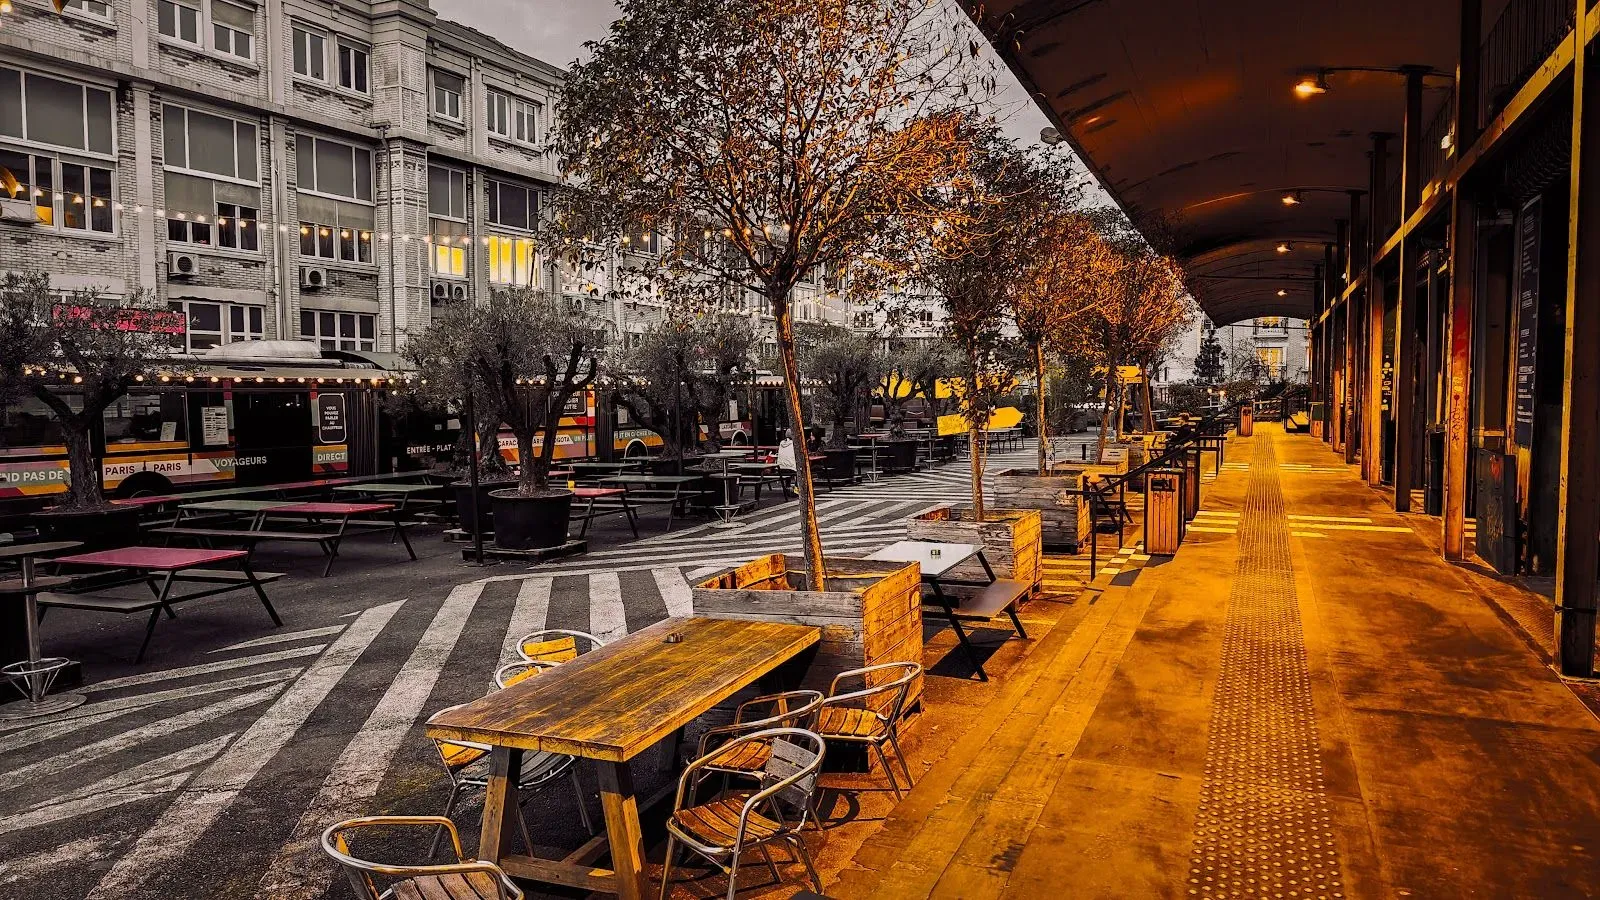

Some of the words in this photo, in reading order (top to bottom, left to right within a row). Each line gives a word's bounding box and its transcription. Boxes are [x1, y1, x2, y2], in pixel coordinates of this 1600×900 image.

[406, 444, 430, 454] ENTRÉE
[436, 444, 451, 452] PLAT
[214, 456, 267, 467] VOYAGEURS
[317, 452, 346, 462] DIRECT
[105, 466, 135, 475] PARIS
[153, 463, 181, 472] PARIS
[23, 471, 46, 481] PAS
[49, 471, 63, 480] DE
